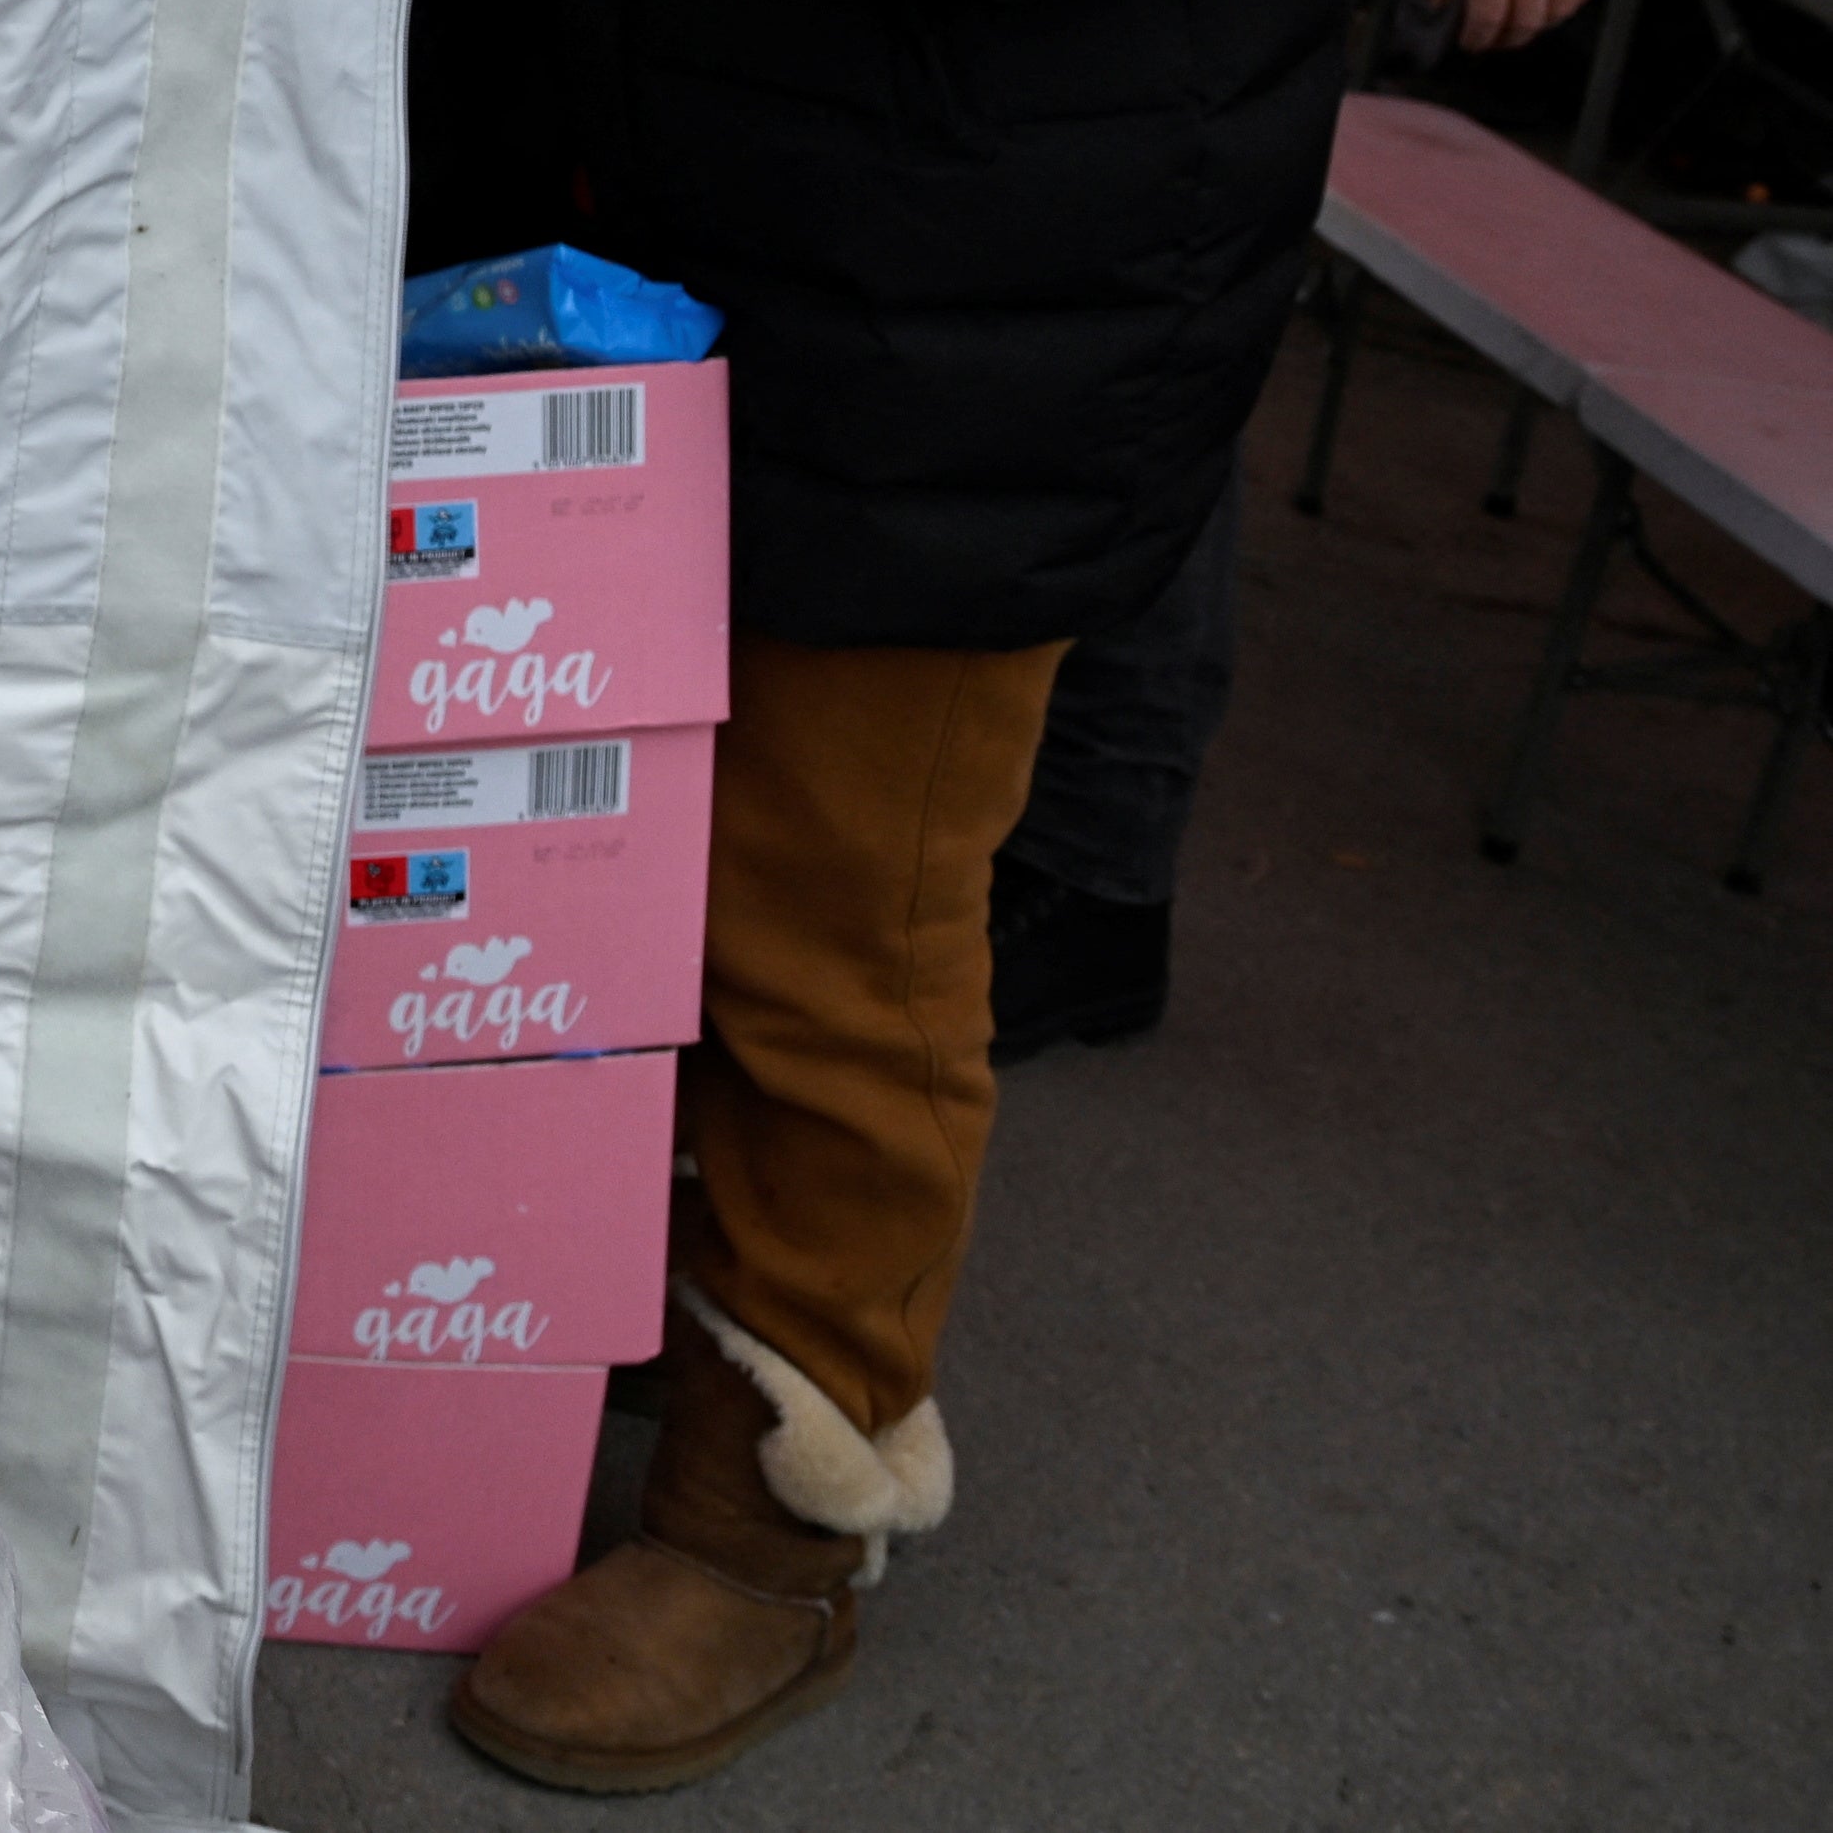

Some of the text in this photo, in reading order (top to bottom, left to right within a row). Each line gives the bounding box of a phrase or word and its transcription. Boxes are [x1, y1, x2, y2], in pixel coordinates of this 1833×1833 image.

[410, 650, 612, 733] gaga
[389, 981, 588, 1057] gaga
[354, 1300, 550, 1363] gaga
[267, 1575, 459, 1640] gaga
